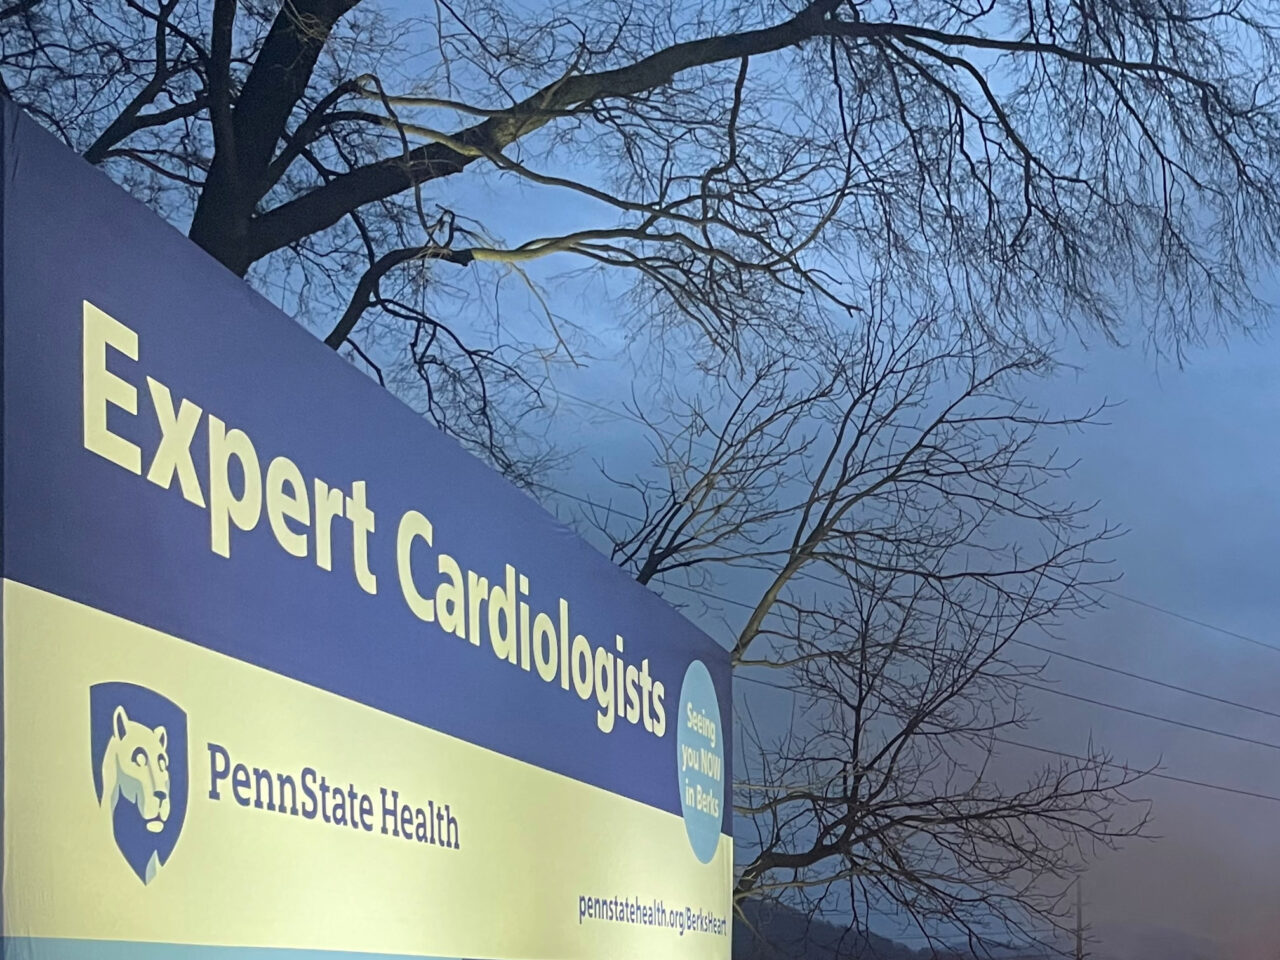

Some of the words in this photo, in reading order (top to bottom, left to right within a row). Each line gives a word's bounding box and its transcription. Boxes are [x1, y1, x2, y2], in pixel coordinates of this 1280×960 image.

[83, 299, 377, 595] Expert
[397, 509, 666, 738] Cardiologists
[687, 702, 716, 748] Seeing
[682, 744, 699, 772] you
[701, 748, 720, 782] NOW
[207, 742, 374, 832] PennState
[379, 787, 460, 850] Health
[685, 777, 695, 808] in
[696, 784, 719, 819] Berks
[578, 895, 727, 937] pennstatehealth.org/BerksHeart
